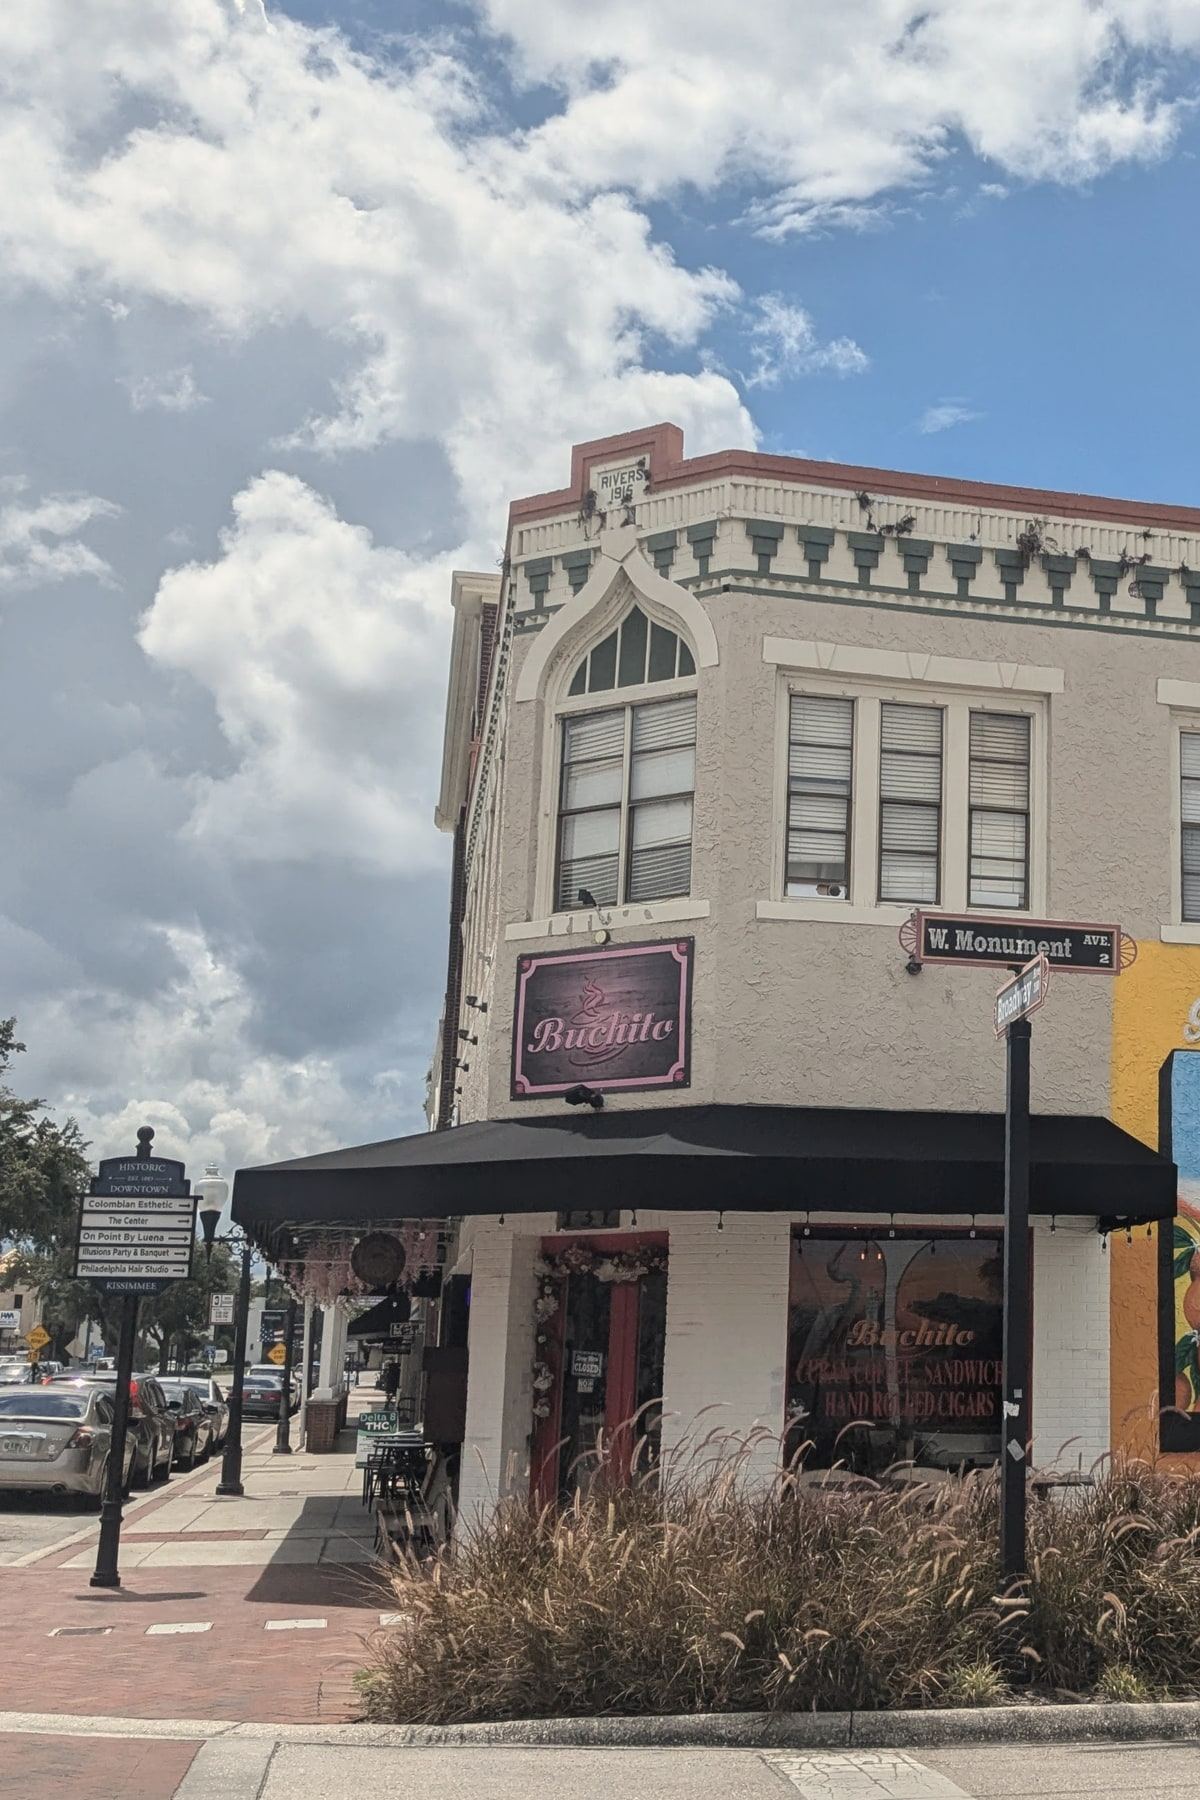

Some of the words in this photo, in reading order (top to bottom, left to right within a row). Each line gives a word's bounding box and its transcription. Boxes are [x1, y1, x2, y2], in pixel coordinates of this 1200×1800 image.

[601, 469, 643, 489] RIVERS
[611, 484, 633, 501] 1915
[928, 927, 949, 950] W.
[955, 929, 1072, 958] Monument
[1082, 934, 1111, 947] AVE.
[1099, 953, 1109, 964] 2
[997, 979, 1032, 1023] Broadway
[528, 1011, 674, 1053] Buchito
[119, 1163, 166, 1172] HISTORIC
[110, 1185, 169, 1193] DOWNTOWN
[88, 1200, 136, 1208] Colombian
[138, 1201, 173, 1209] Esthetic
[124, 1217, 149, 1225] Center
[83, 1232, 95, 1240] On
[124, 1233, 135, 1242] By
[82, 1248, 111, 1256] Illusions
[112, 1249, 132, 1257] Party
[140, 1249, 169, 1257] Banquet
[80, 1265, 126, 1273] Philadelphia
[128, 1265, 144, 1273] Hair
[145, 1265, 169, 1273] Studio
[106, 1281, 157, 1290] KISSIMMEE
[847, 1319, 976, 1346] Buchito
[575, 1363, 599, 1373] CLOSED
[825, 1391, 869, 1416] HAND
[938, 1391, 995, 1416] CIGARS
[360, 1413, 387, 1421] Delta
[390, 1412, 396, 1421] 8
[365, 1421, 390, 1430] THC
